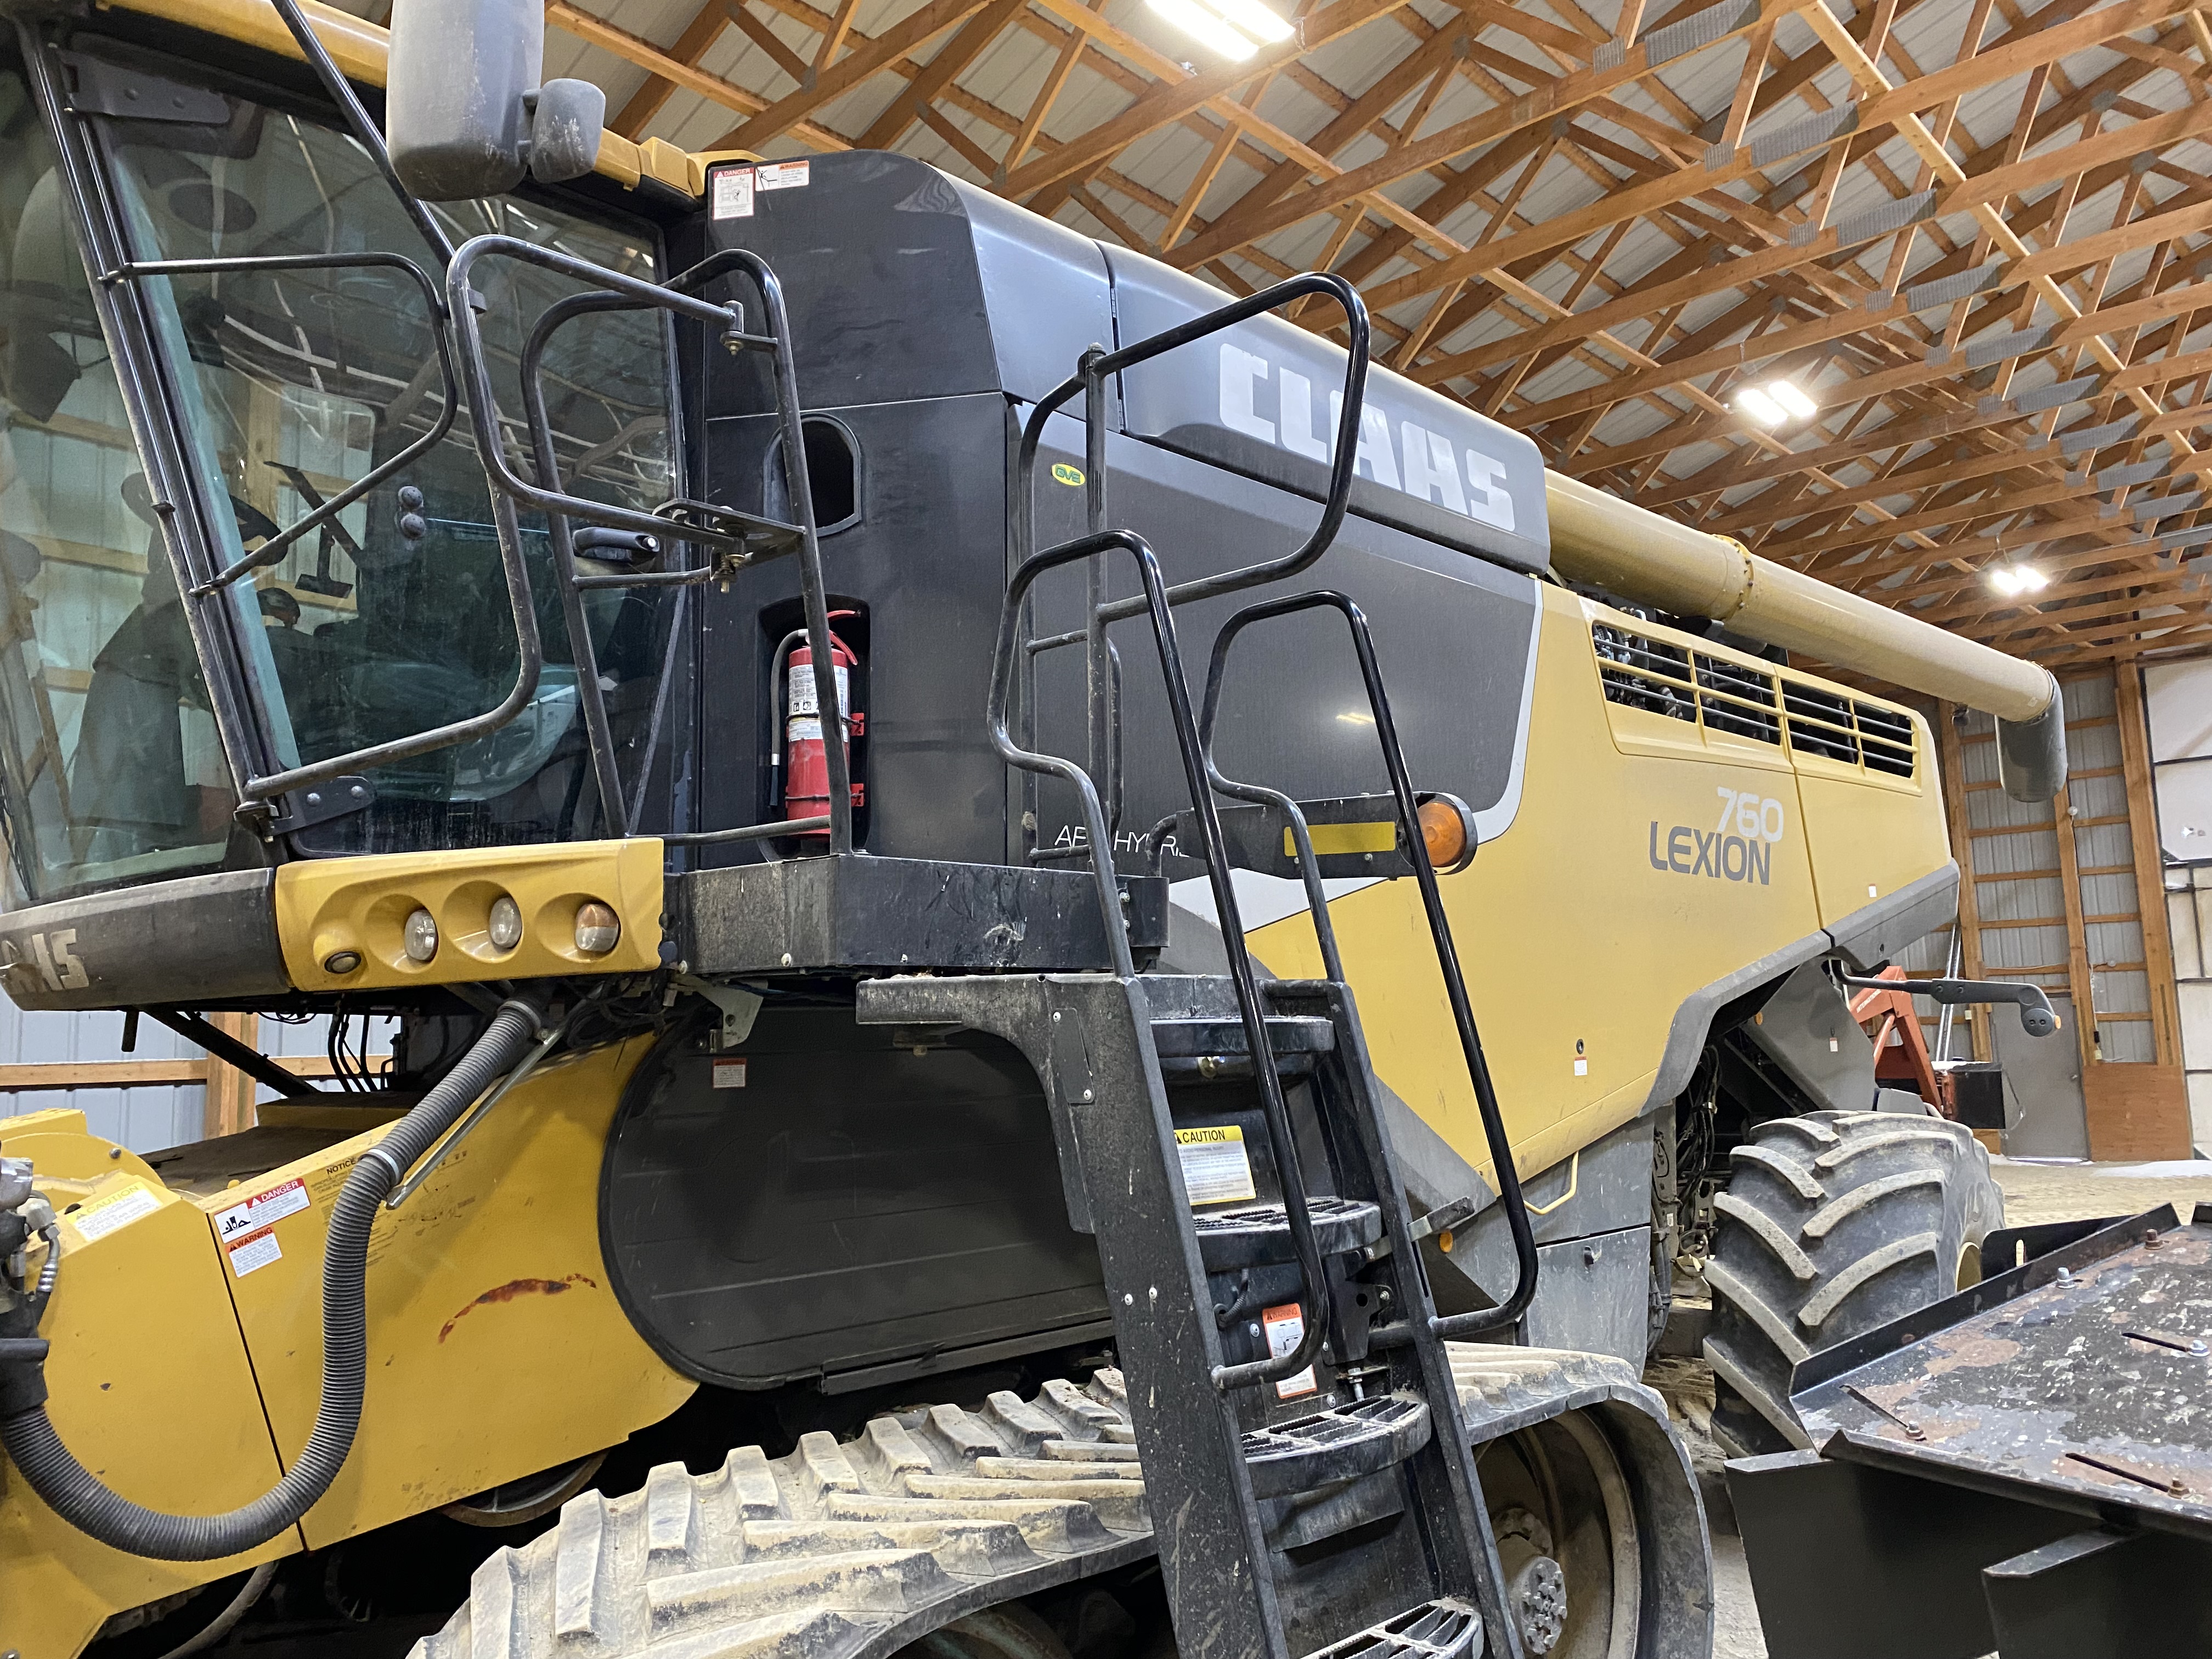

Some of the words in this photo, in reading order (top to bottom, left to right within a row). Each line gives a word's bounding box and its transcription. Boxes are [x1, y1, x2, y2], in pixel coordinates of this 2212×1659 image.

[724, 168, 751, 176] DANGER
[1220, 343, 1515, 532] CLAAS
[1717, 786, 1784, 843] 760
[1649, 821, 1770, 885] LEXION
[1182, 1130, 1226, 1143] CAUTION
[87, 1186, 139, 1214] CAUTION
[261, 1180, 299, 1202] DANGER
[236, 1227, 273, 1247] WARNING
